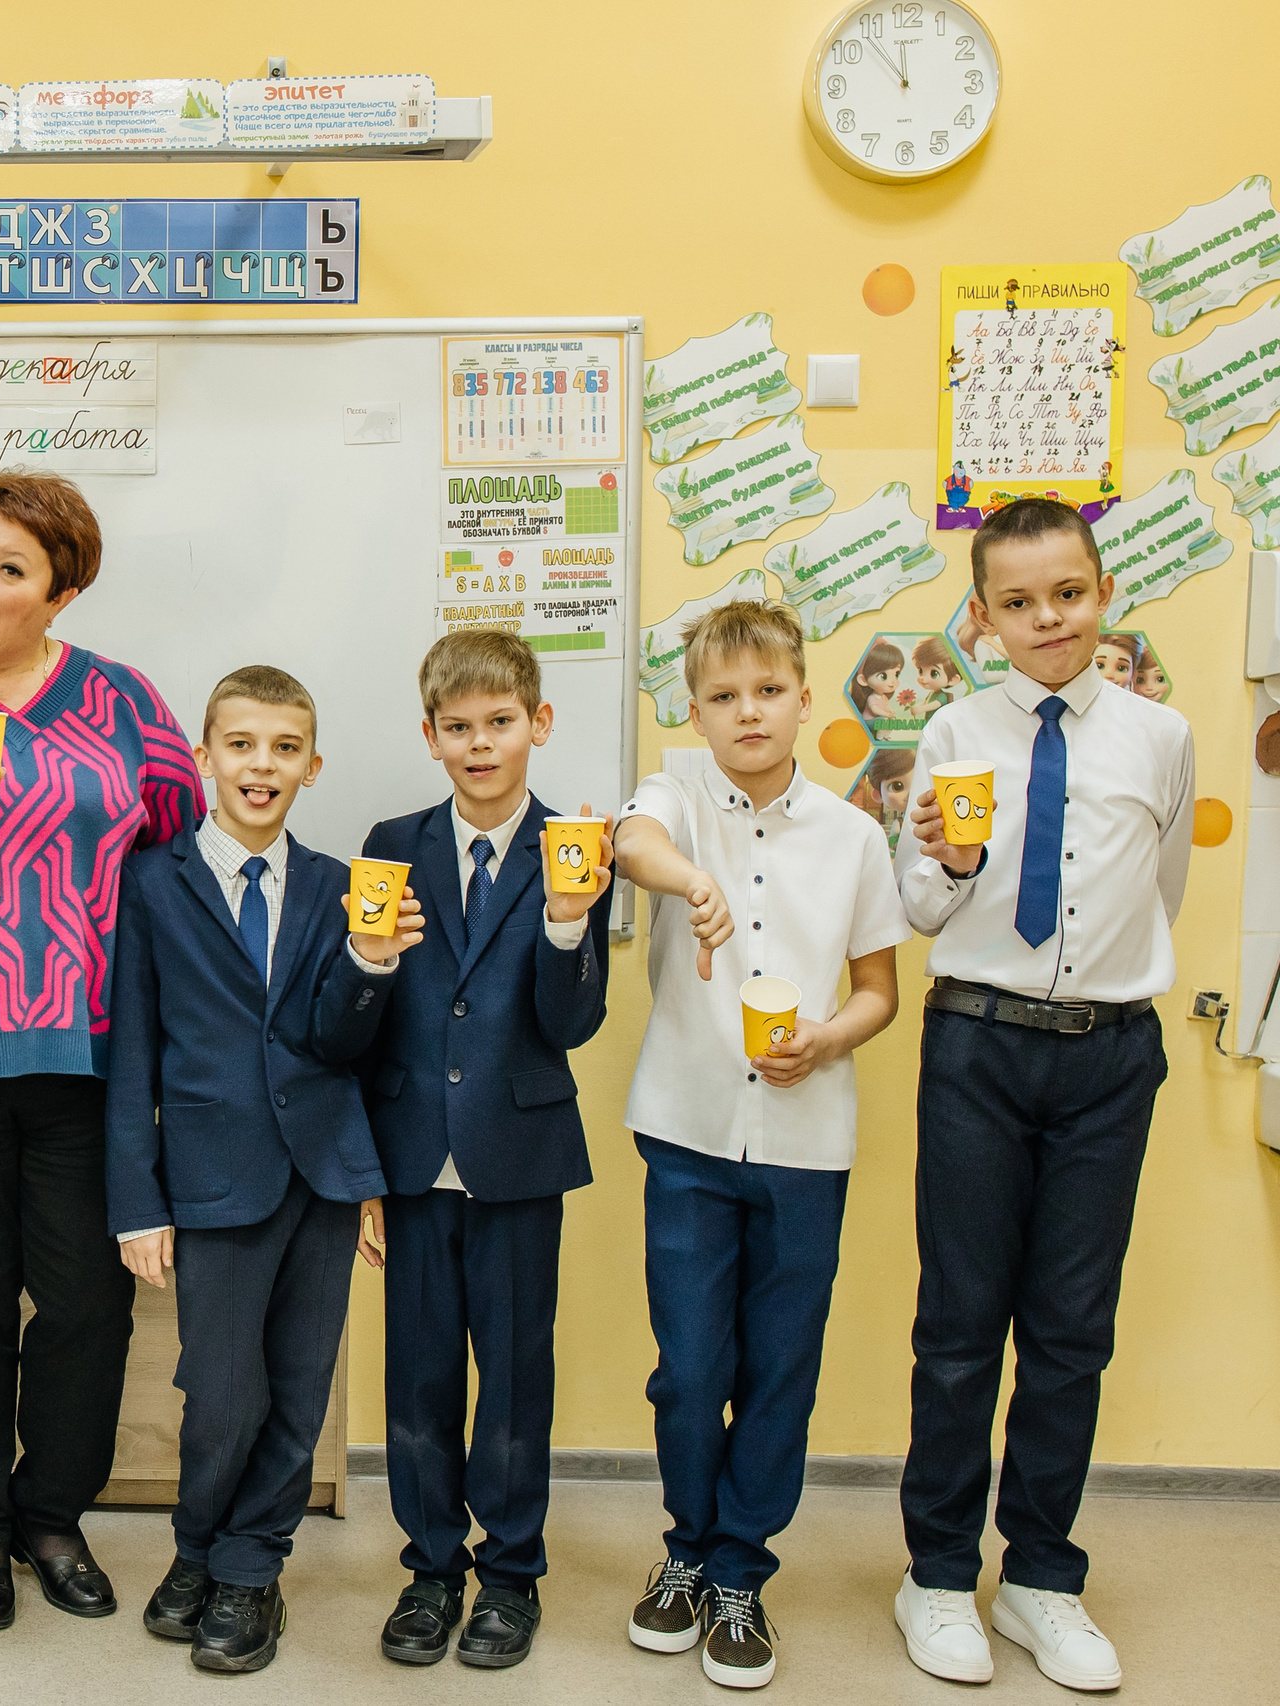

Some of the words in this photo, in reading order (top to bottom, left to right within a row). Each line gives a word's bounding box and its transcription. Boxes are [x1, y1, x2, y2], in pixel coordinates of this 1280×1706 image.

[860, 14, 883, 38] 11
[892, 3, 923, 29] 12
[935, 11, 946, 36] 1
[832, 39, 863, 64] 10
[955, 36, 975, 60] 2
[264, 84, 346, 101] эпитет
[827, 74, 847, 99] 9
[964, 70, 984, 94] 3
[233, 113, 281, 122] красочное
[284, 111, 346, 120] определение
[262, 103, 307, 112] средство
[954, 105, 975, 129] 4
[78, 128, 117, 136] скрытое
[265, 122, 291, 130] всего
[836, 109, 856, 133] 8
[861, 133, 880, 157] 7
[895, 141, 915, 165] 6
[929, 131, 949, 155] 5
[1139, 247, 1200, 283] Хорошая
[1200, 226, 1242, 252] книга
[1243, 209, 1276, 233] ярче
[957, 285, 1000, 299] ПИШИ
[1022, 284, 1110, 298] ПРАВИЛЬНО
[485, 343, 514, 353] КЛАССЫ
[523, 343, 558, 353] РАЗРЯДЫ
[560, 342, 583, 352] ЧИСЕЛ
[452, 372, 488, 396] 835
[493, 371, 527, 396] 772
[532, 370, 567, 395] 138
[573, 370, 609, 393] 463
[667, 374, 715, 403] умного
[716, 351, 767, 380] соседа
[1178, 371, 1224, 399] Книга
[1222, 350, 1258, 374] твой
[662, 402, 710, 429] книгой
[710, 369, 786, 410] побеседуй
[1185, 406, 1211, 425] без
[1211, 392, 1237, 411] нее
[1236, 377, 1264, 397] как
[736, 441, 791, 473] книжки
[448, 474, 563, 504] ПЛОЩАДЬ
[731, 473, 785, 501] будешь
[786, 460, 812, 477] все
[447, 518, 481, 529] ПЛОСКОЙ
[529, 516, 563, 526] ПРИНЯТО
[460, 510, 475, 519] ЭТО
[477, 508, 525, 519] ВНУТРЕННЯЯ
[527, 507, 550, 517] ЧАСТЬ
[735, 505, 775, 528] знать
[1122, 495, 1190, 544] добывают
[463, 526, 510, 538] ОБОЗНАЧАТЬ
[512, 525, 541, 536] БУКВОЙ
[1147, 544, 1157, 555] а
[1156, 517, 1203, 549] знания
[542, 548, 615, 567] ПЛОЩАДЬ
[794, 556, 838, 582] Книги
[838, 530, 887, 560] читать
[457, 576, 467, 593] S
[542, 581, 570, 590] ДЛИНЫ
[579, 579, 612, 589] ШИРИНЫ
[548, 570, 608, 580] ПРОИЗВЕДЕНИЕ
[811, 575, 855, 602] скуки
[854, 565, 872, 580] не
[870, 543, 910, 571] знать
[1125, 580, 1143, 595] из
[443, 600, 525, 622] КВАДРАТНЫЙ
[534, 602, 546, 611] ЭТО
[548, 601, 581, 611] ПЛОЩАДЬ
[582, 599, 617, 611] КВАДРАТА
[544, 610, 553, 619] СО
[555, 608, 589, 619] СТОРОНОЙ
[874, 719, 926, 731] ВНИМАН
